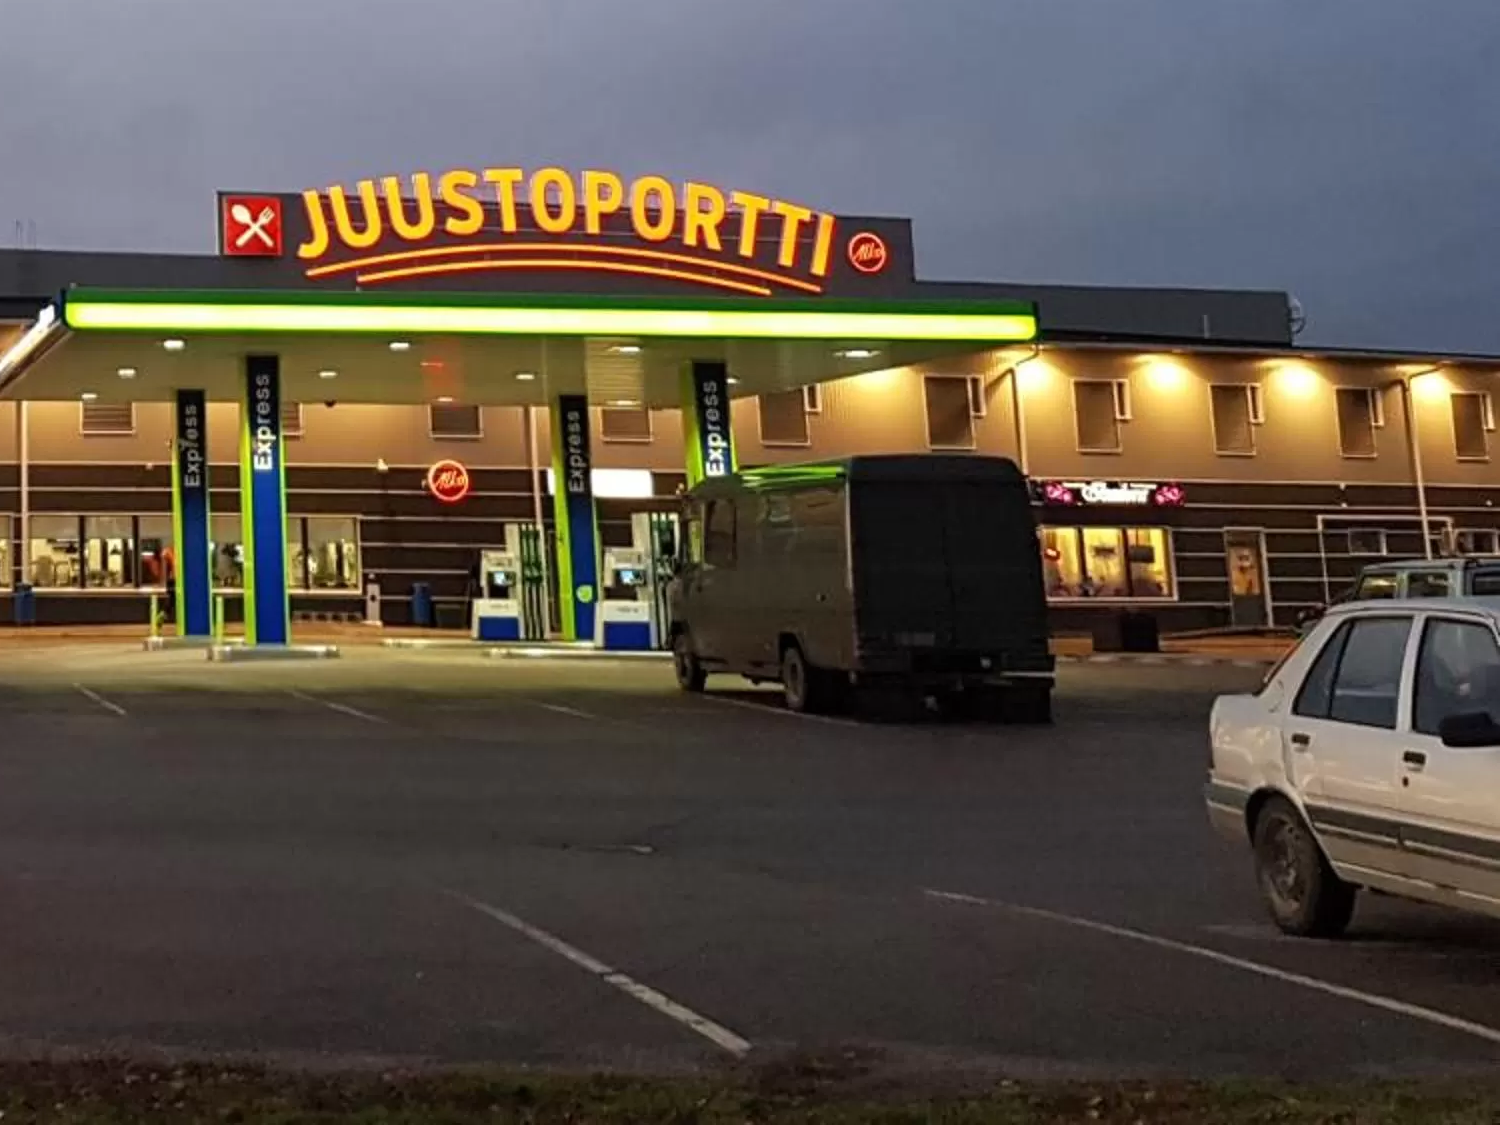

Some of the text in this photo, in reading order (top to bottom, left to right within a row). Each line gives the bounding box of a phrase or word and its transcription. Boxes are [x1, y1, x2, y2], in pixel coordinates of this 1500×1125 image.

[296, 166, 836, 277] JUUSTOPORTTI
[254, 374, 277, 470] Express
[567, 410, 587, 493] Express
[703, 380, 728, 476] Express
